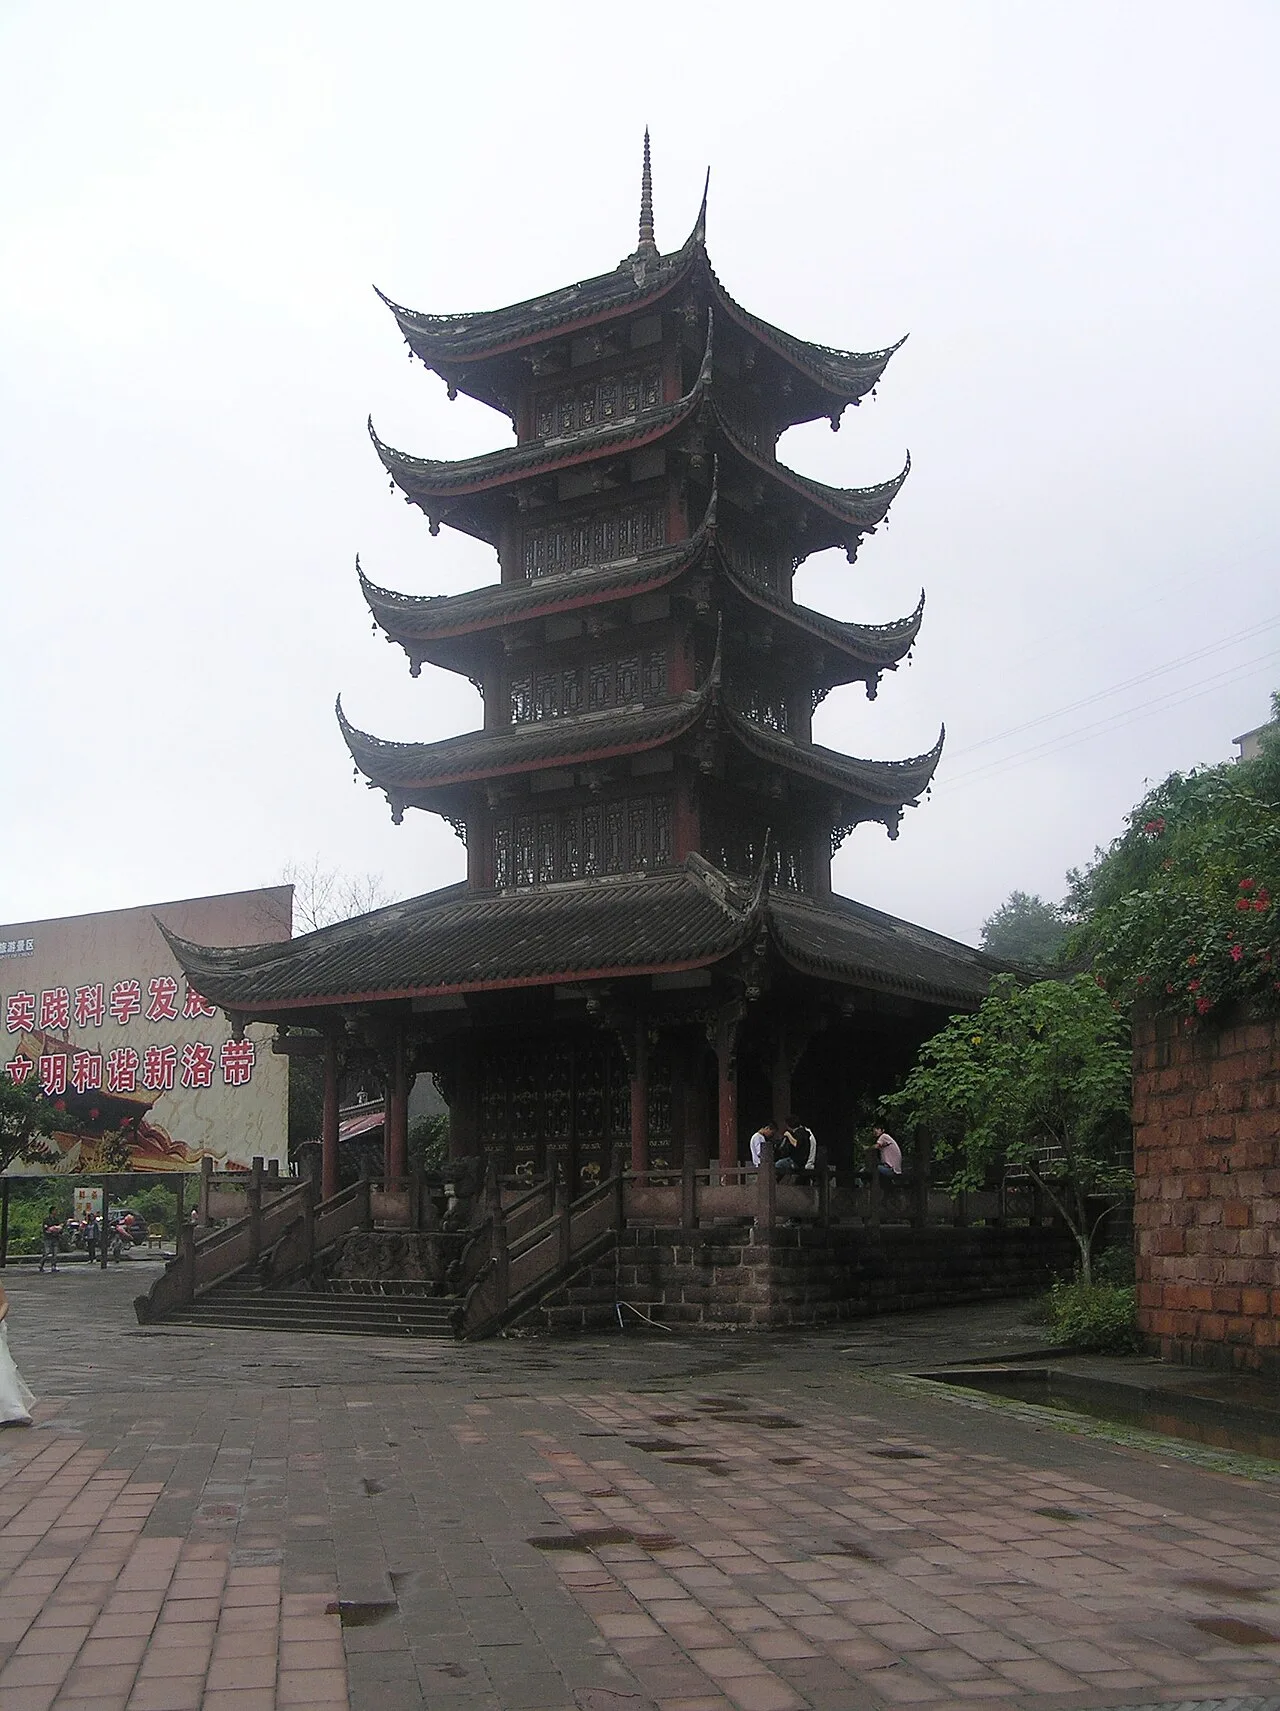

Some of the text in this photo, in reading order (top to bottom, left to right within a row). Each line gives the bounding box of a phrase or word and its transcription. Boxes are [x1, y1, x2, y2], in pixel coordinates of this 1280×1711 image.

[5, 1039, 254, 1096] 文明和谐新洛带
